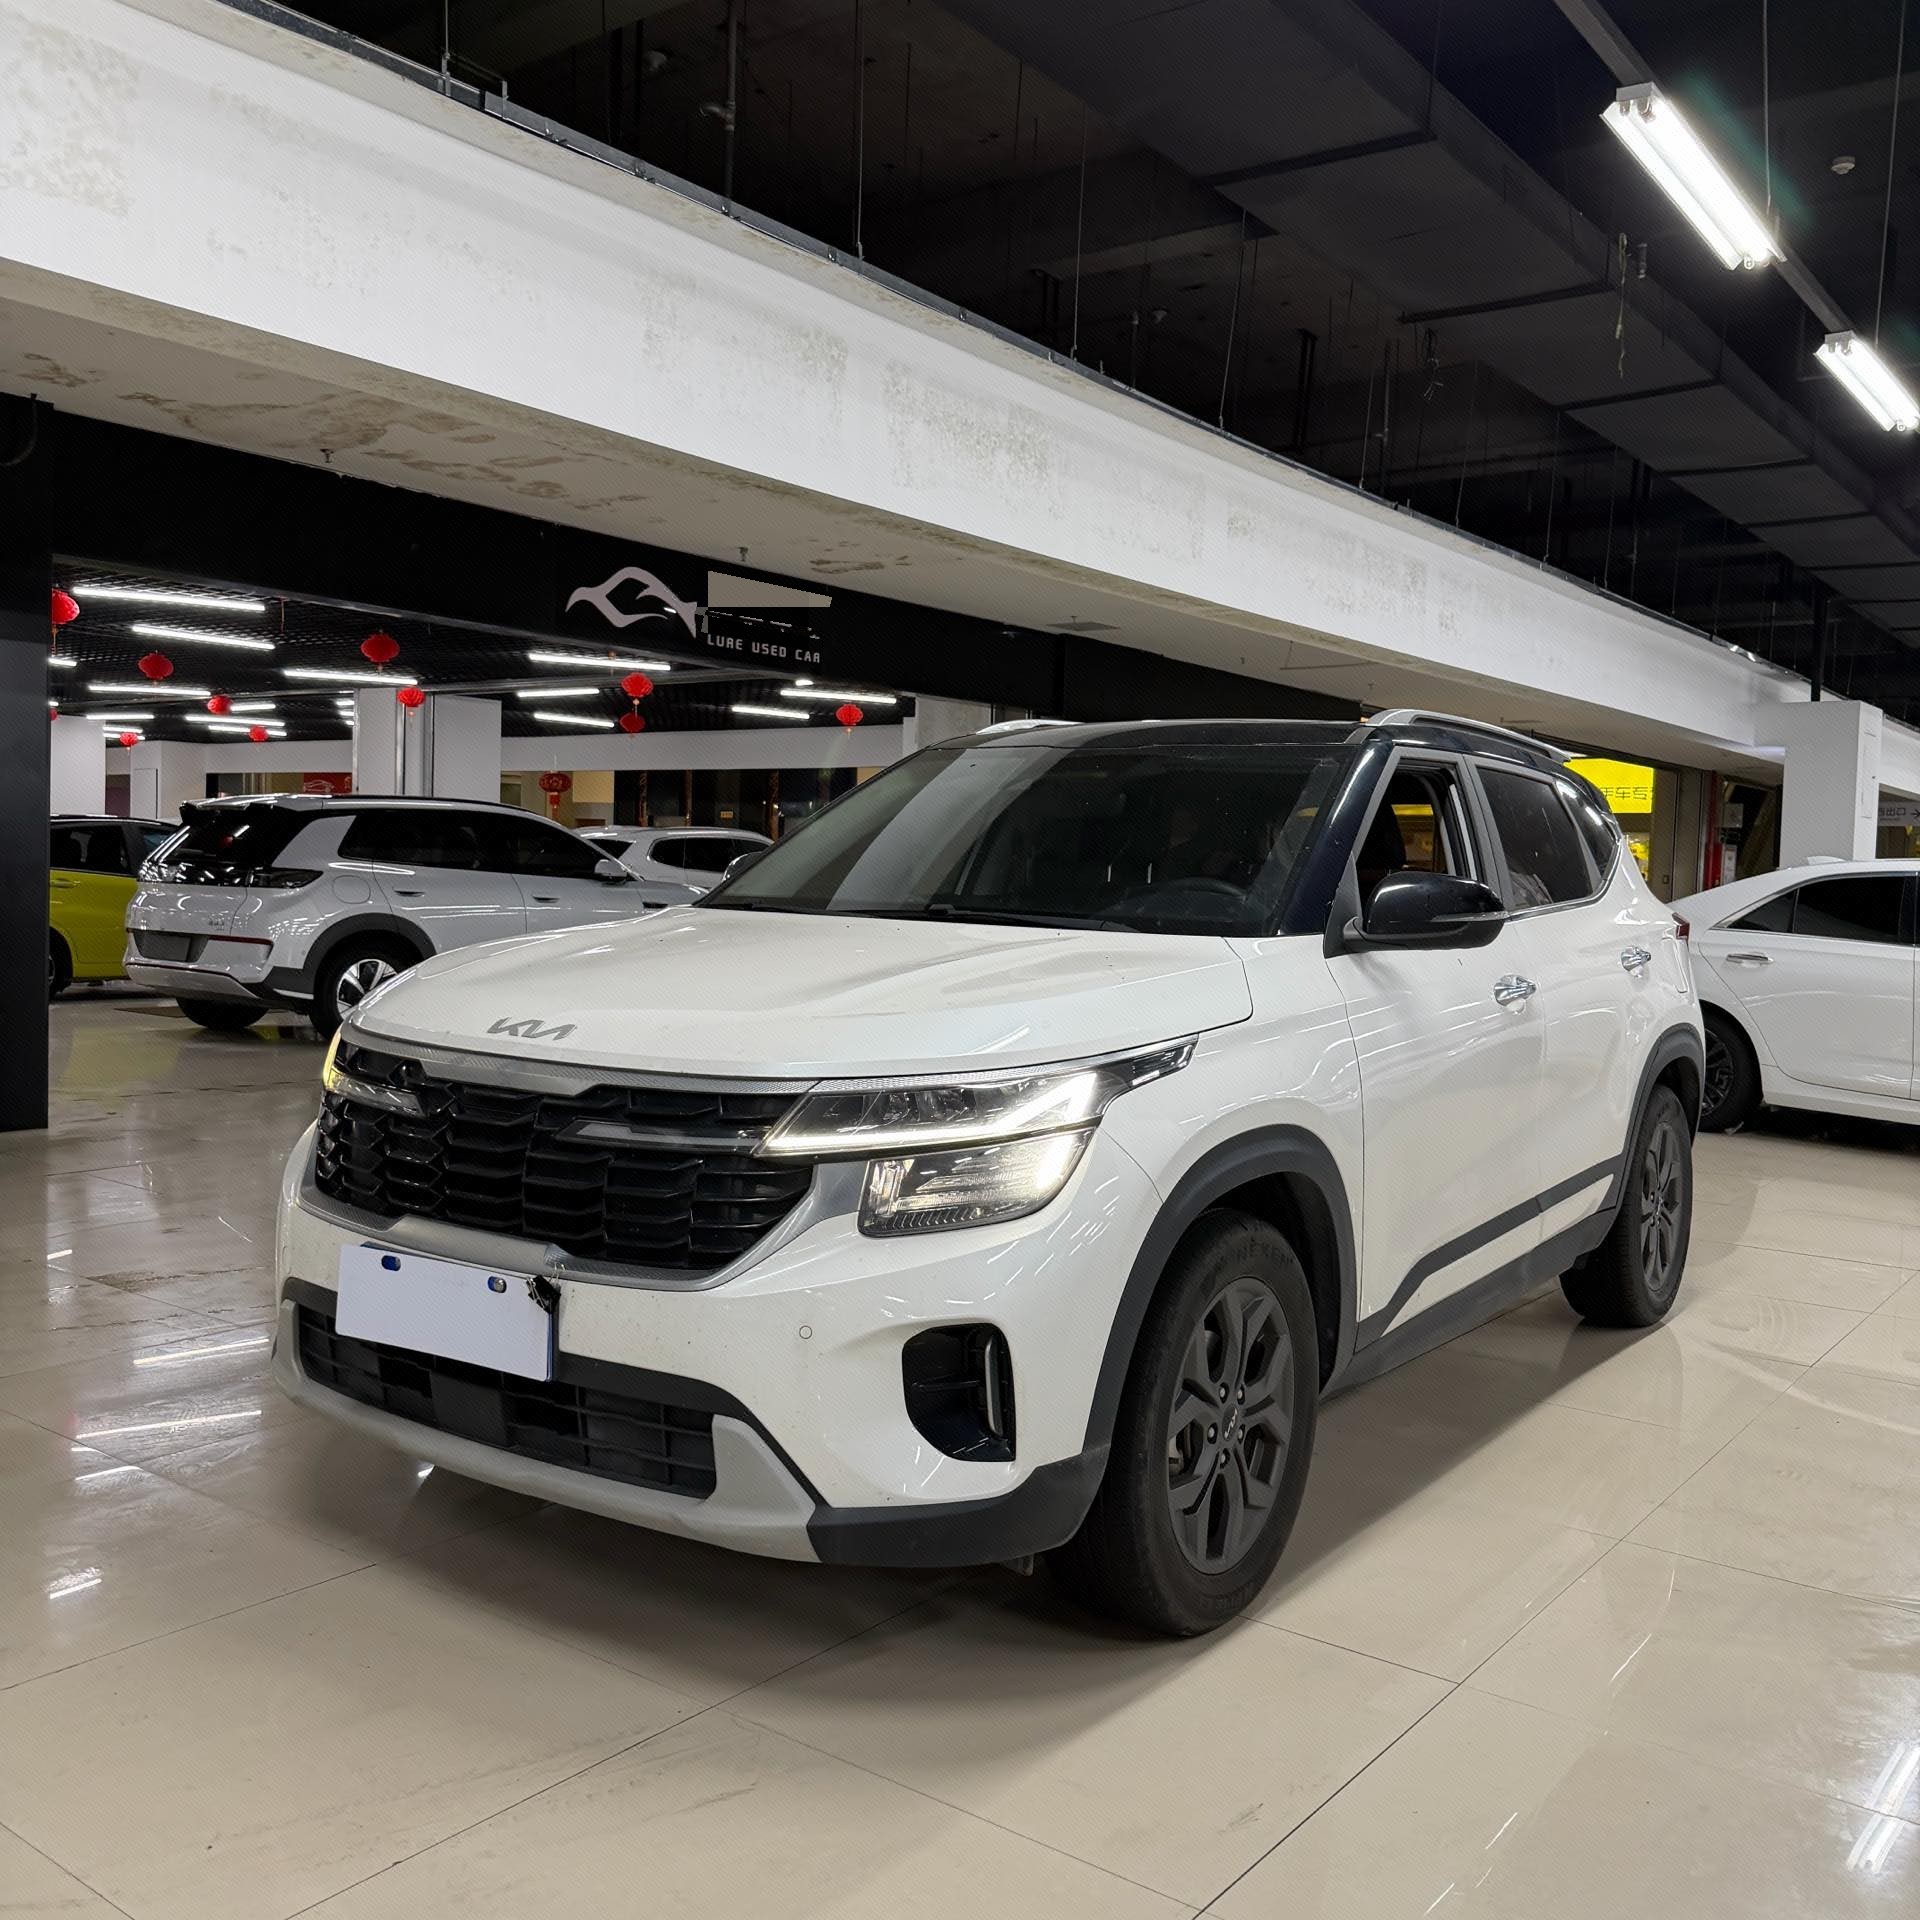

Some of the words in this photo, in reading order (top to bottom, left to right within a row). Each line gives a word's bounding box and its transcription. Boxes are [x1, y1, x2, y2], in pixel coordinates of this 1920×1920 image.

[751, 642, 787, 658] USED
[795, 649, 820, 664] CAR
[487, 1017, 577, 1040] KIA
